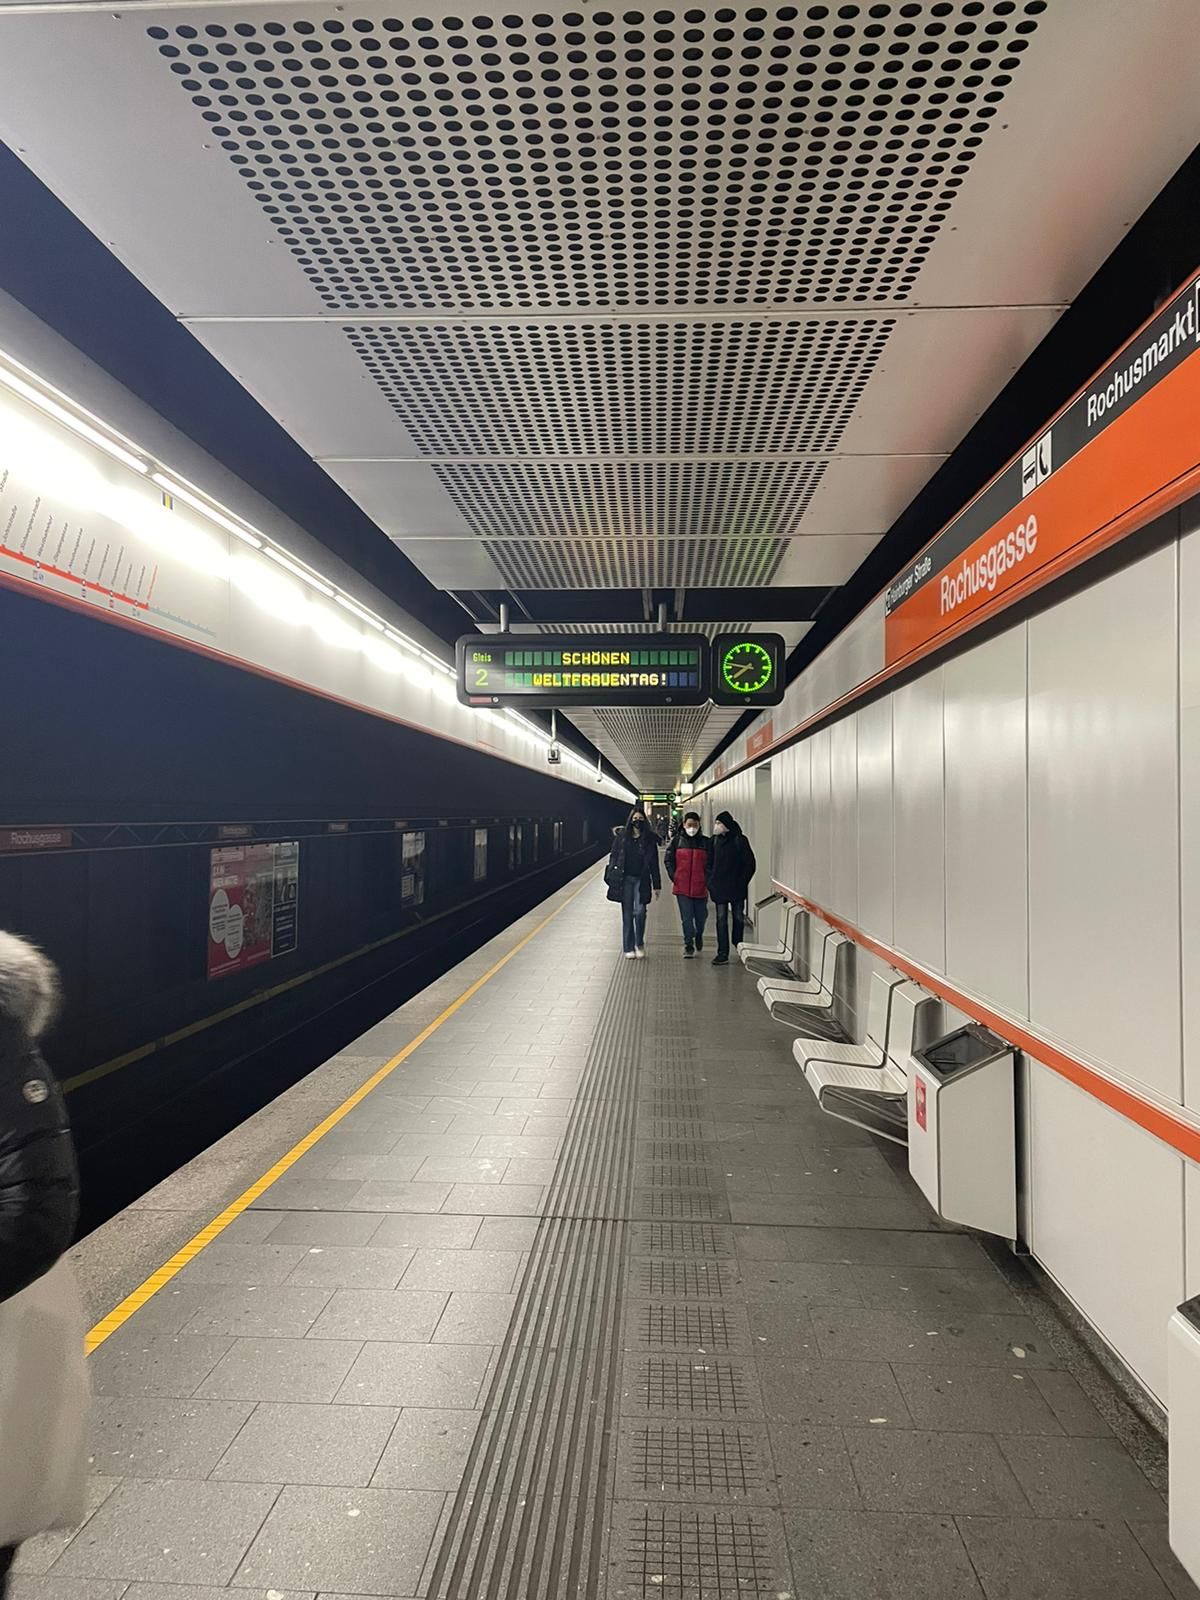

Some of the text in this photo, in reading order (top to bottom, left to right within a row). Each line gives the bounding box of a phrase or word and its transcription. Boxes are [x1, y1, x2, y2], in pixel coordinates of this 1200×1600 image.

[1087, 299, 1194, 427] Rochusmarkt
[914, 556, 932, 583] Straße
[941, 514, 1038, 616] Rochusgasse
[472, 652, 492, 663] Gleis
[562, 651, 630, 666] SCHÖNEN
[475, 668, 489, 687] 2
[532, 672, 667, 687] WELTFRAUENTAG!
